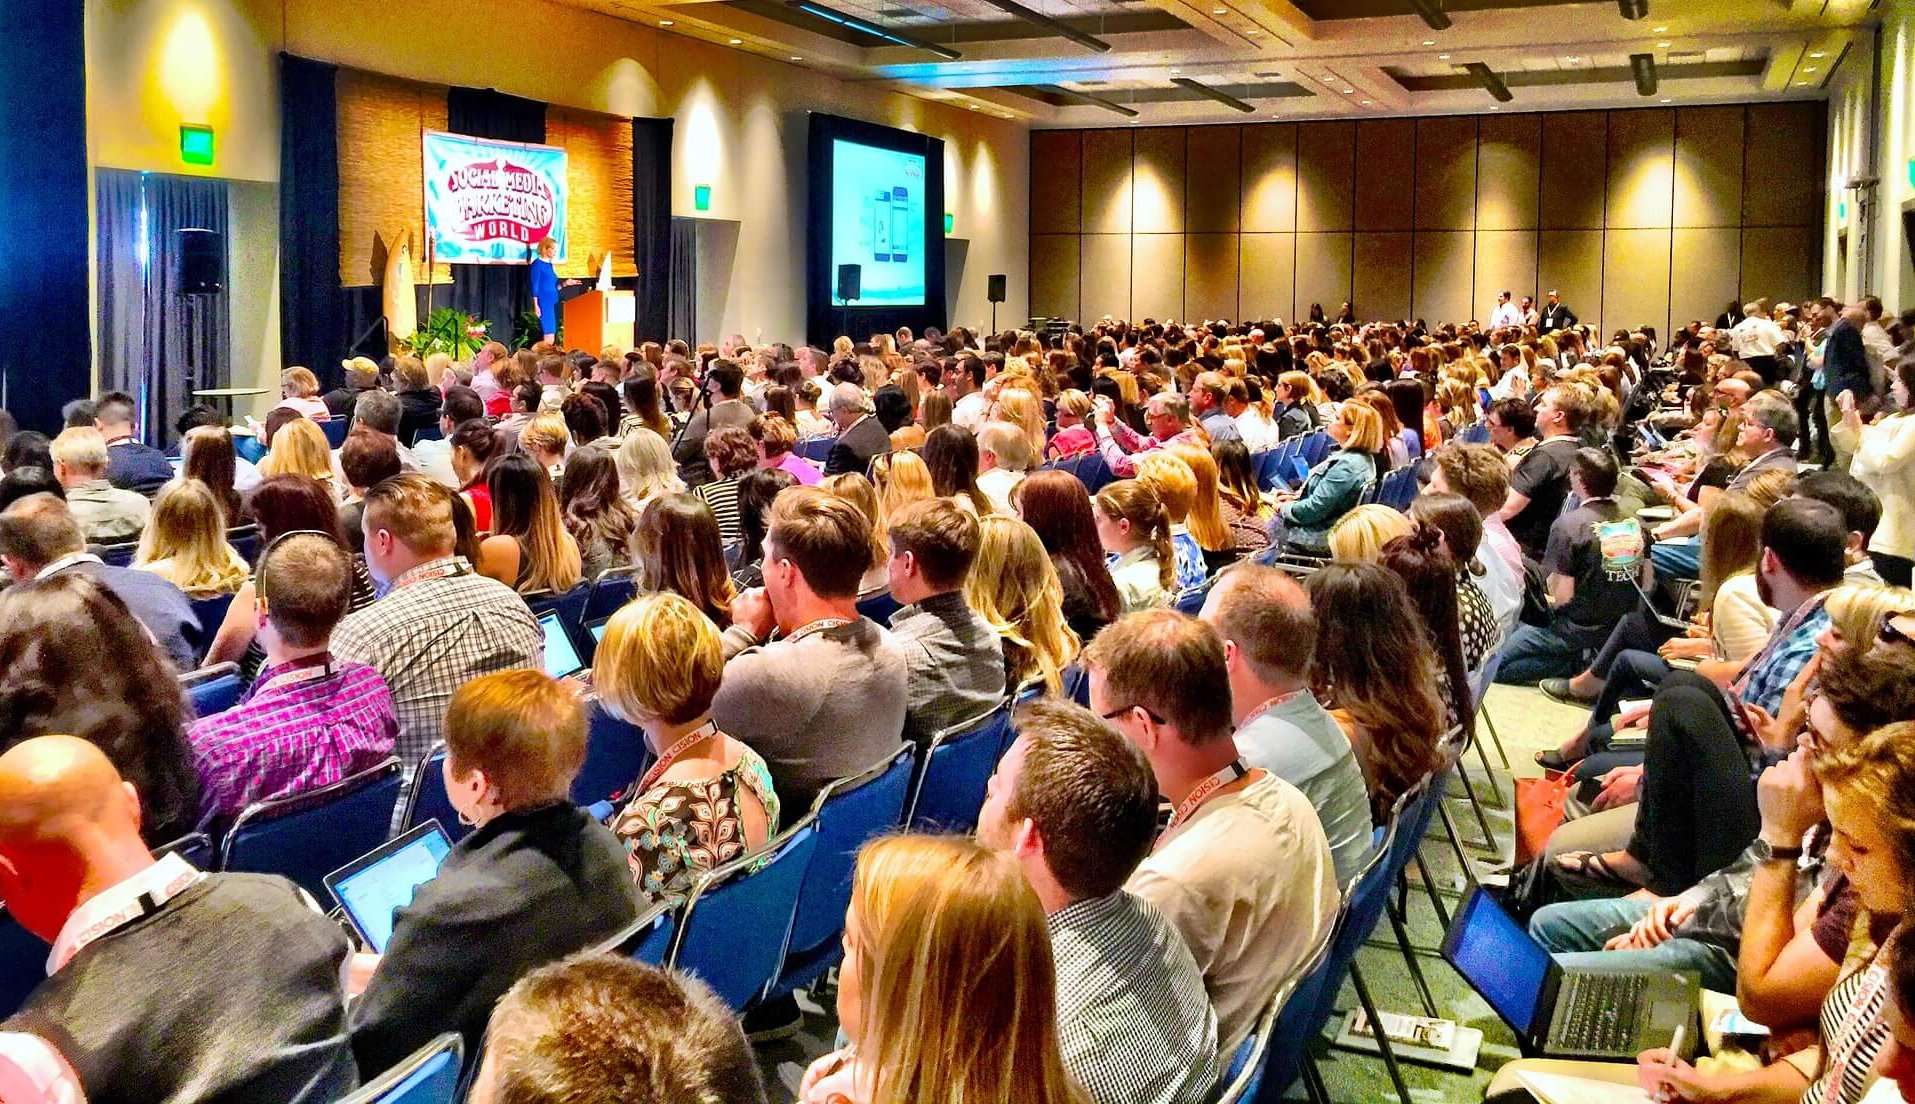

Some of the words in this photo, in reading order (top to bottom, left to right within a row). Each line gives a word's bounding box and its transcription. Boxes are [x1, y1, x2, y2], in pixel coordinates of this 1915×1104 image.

[504, 171, 548, 200] MEDIA
[473, 221, 529, 242] WORLD
[672, 732, 702, 754] CISION
[1189, 776, 1221, 806] CISION
